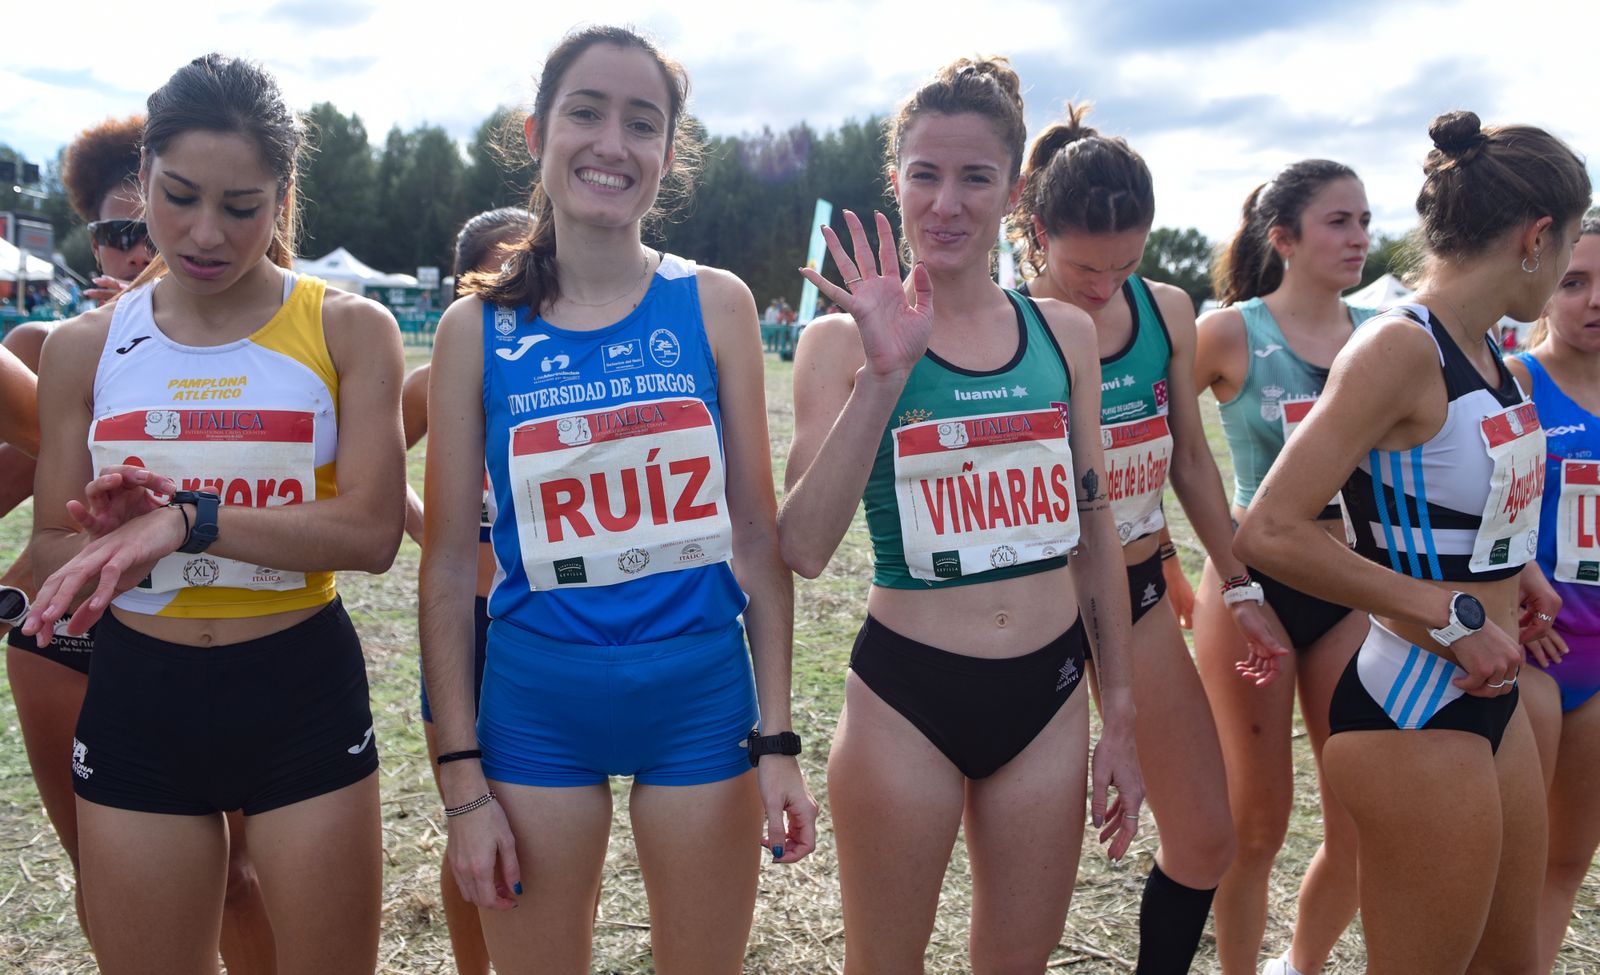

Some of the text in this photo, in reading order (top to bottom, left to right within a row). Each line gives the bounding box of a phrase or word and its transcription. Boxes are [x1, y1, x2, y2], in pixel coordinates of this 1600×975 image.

[168, 375, 247, 389] PAMPLONA
[1101, 377, 1120, 391] nvi
[172, 386, 242, 400] ATLÉTICO
[507, 373, 696, 416] UNIVERSIDAD DE BURGOS
[954, 387, 1008, 401] luanvi
[187, 410, 264, 431] ITALICA
[595, 404, 665, 432] ITALICA
[972, 415, 1032, 437] ITALICA
[123, 456, 304, 508] rrera
[1105, 459, 1123, 501] dez
[540, 447, 718, 543] RUÍZ
[920, 461, 1070, 535] VIÑARAS
[627, 555, 641, 564] XL
[999, 551, 1011, 562] XL
[192, 566, 210, 577] XL
[51, 637, 95, 649] orvenir
